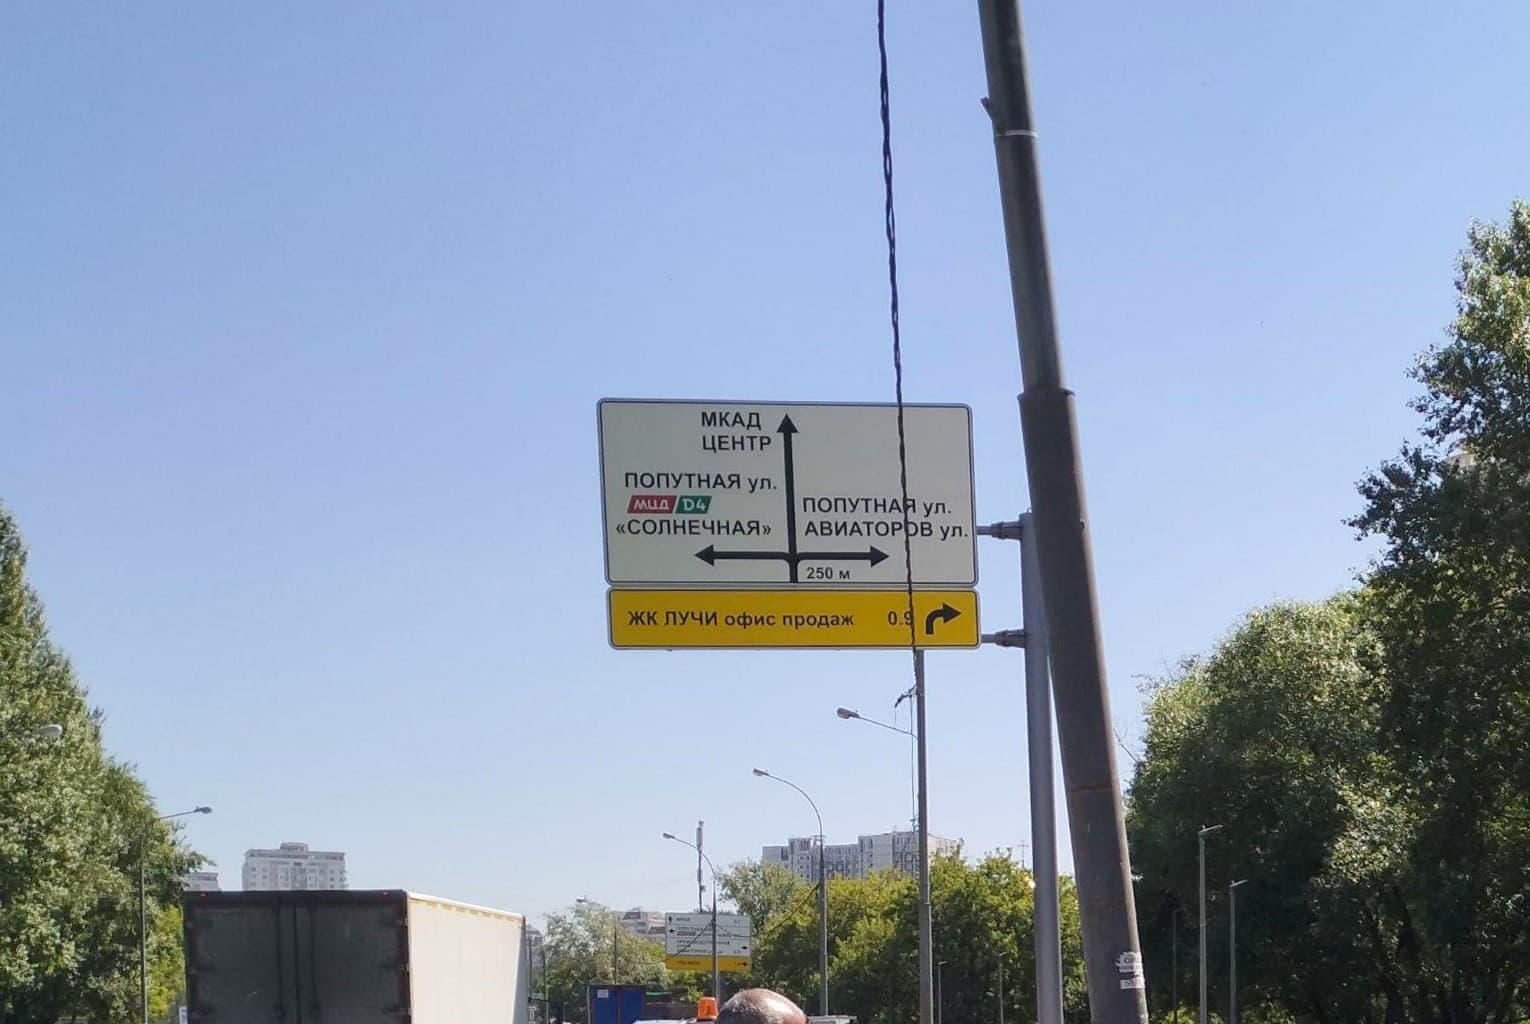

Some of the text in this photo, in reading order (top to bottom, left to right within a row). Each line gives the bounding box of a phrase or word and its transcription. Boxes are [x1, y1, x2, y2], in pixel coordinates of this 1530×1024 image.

[701, 411, 761, 430] МКАД
[702, 435, 772, 453] ЦЕНТР
[624, 472, 778, 492] ПОПУТНАЯ ул.
[632, 498, 670, 511] МЦД
[678, 498, 708, 512] D4
[802, 497, 952, 517] ПОПУТНАЯ ул.
[615, 519, 772, 536] «СОЛНЕЧНАЯ»
[804, 521, 969, 540] АВИАТОРОВ ул.
[806, 566, 850, 580] 250 м
[628, 611, 658, 627] ЖК
[663, 611, 718, 627] ЛУЧИ
[724, 611, 776, 631] офис
[781, 613, 854, 632] продаж
